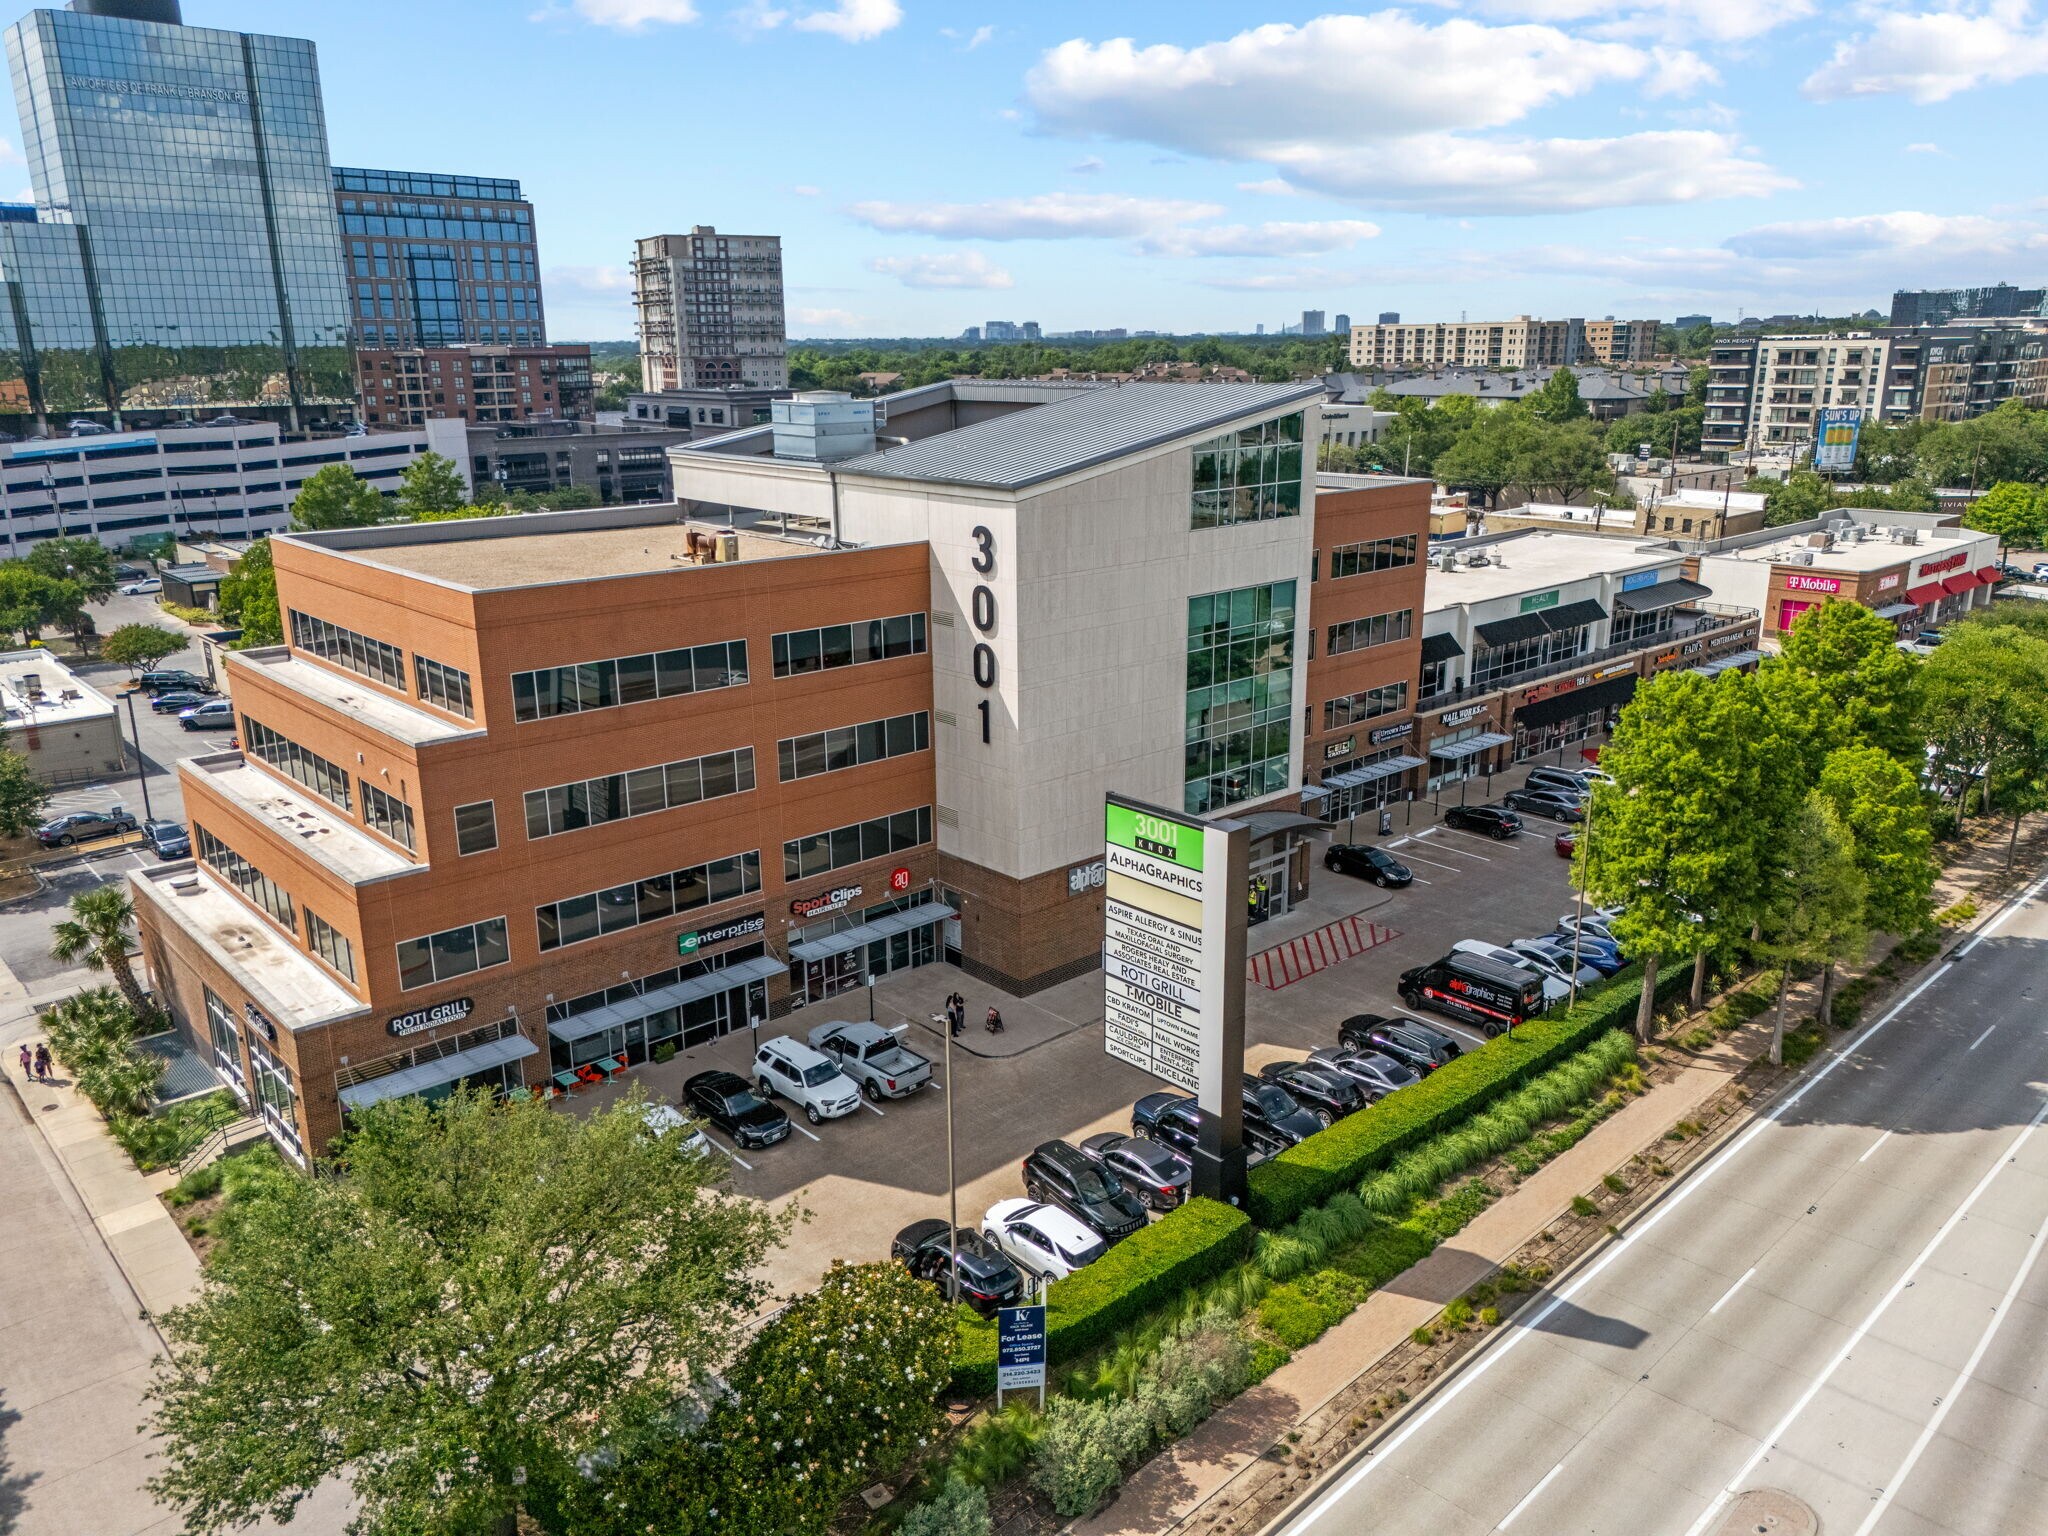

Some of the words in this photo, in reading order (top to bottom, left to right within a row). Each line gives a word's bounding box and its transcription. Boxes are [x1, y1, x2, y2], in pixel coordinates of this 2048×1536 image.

[90, 79, 128, 92] OFFICES
[131, 82, 142, 93] OF
[145, 84, 176, 96] FRANK
[1824, 410, 1847, 421] SUN'S
[1849, 410, 1860, 421] UP
[1800, 577, 1837, 592] Mobile
[971, 525, 995, 744] 3001
[1442, 712, 1459, 724] NAIL
[1135, 814, 1178, 846] 3001
[1138, 839, 1173, 857] KNOX
[808, 901, 846, 916] HAIRCUTS
[681, 917, 764, 948] enterprise
[1108, 905, 1133, 921] ASPIRE
[1135, 915, 1168, 933] ALLERGY
[1170, 927, 1176, 936] &
[1177, 930, 1202, 946] SINUS
[1115, 930, 1163, 954] MAXILLOFACIAL
[1164, 949, 1194, 965] SURGERY
[1127, 927, 1146, 940] TEXAS
[1147, 936, 1165, 947] ORAL
[1166, 943, 1181, 953] AND
[1114, 949, 1152, 969] ASSOCIATES
[1153, 965, 1171, 977] REAL
[1171, 972, 1196, 987] ESTATE
[1121, 944, 1147, 960] ROGERS
[1148, 954, 1169, 967] HEALY
[1171, 964, 1187, 975] AND
[1121, 964, 1148, 986] ROTI
[1151, 977, 1186, 1002] GRILL
[1107, 995, 1120, 1006] CBD
[1121, 1001, 1151, 1019] KRATOM
[1125, 984, 1182, 1019] T-MOBILE
[393, 1011, 427, 1032] ROTI
[430, 1000, 470, 1020] GRILL
[401, 1024, 421, 1036] FRESH
[422, 1017, 446, 1030] INDIAN
[446, 1012, 466, 1022] FOOD
[1117, 1012, 1139, 1028] FADI'S
[1157, 1017, 1180, 1031] UPTOWN
[1180, 1027, 1199, 1039] FRAME
[1109, 1025, 1150, 1048] CAULDRON
[1124, 1040, 1141, 1049] CREAM
[1155, 1031, 1172, 1045] NAIL
[1173, 1040, 1200, 1058] WORKS
[1109, 1044, 1147, 1066] SPORTCLIPS
[1160, 1047, 1195, 1068] ENTERPRISE
[1160, 1054, 1194, 1074] RENT-A-CAR
[1154, 1063, 1200, 1090] JUICELAND
[1016, 1333, 1043, 1341] Lease
